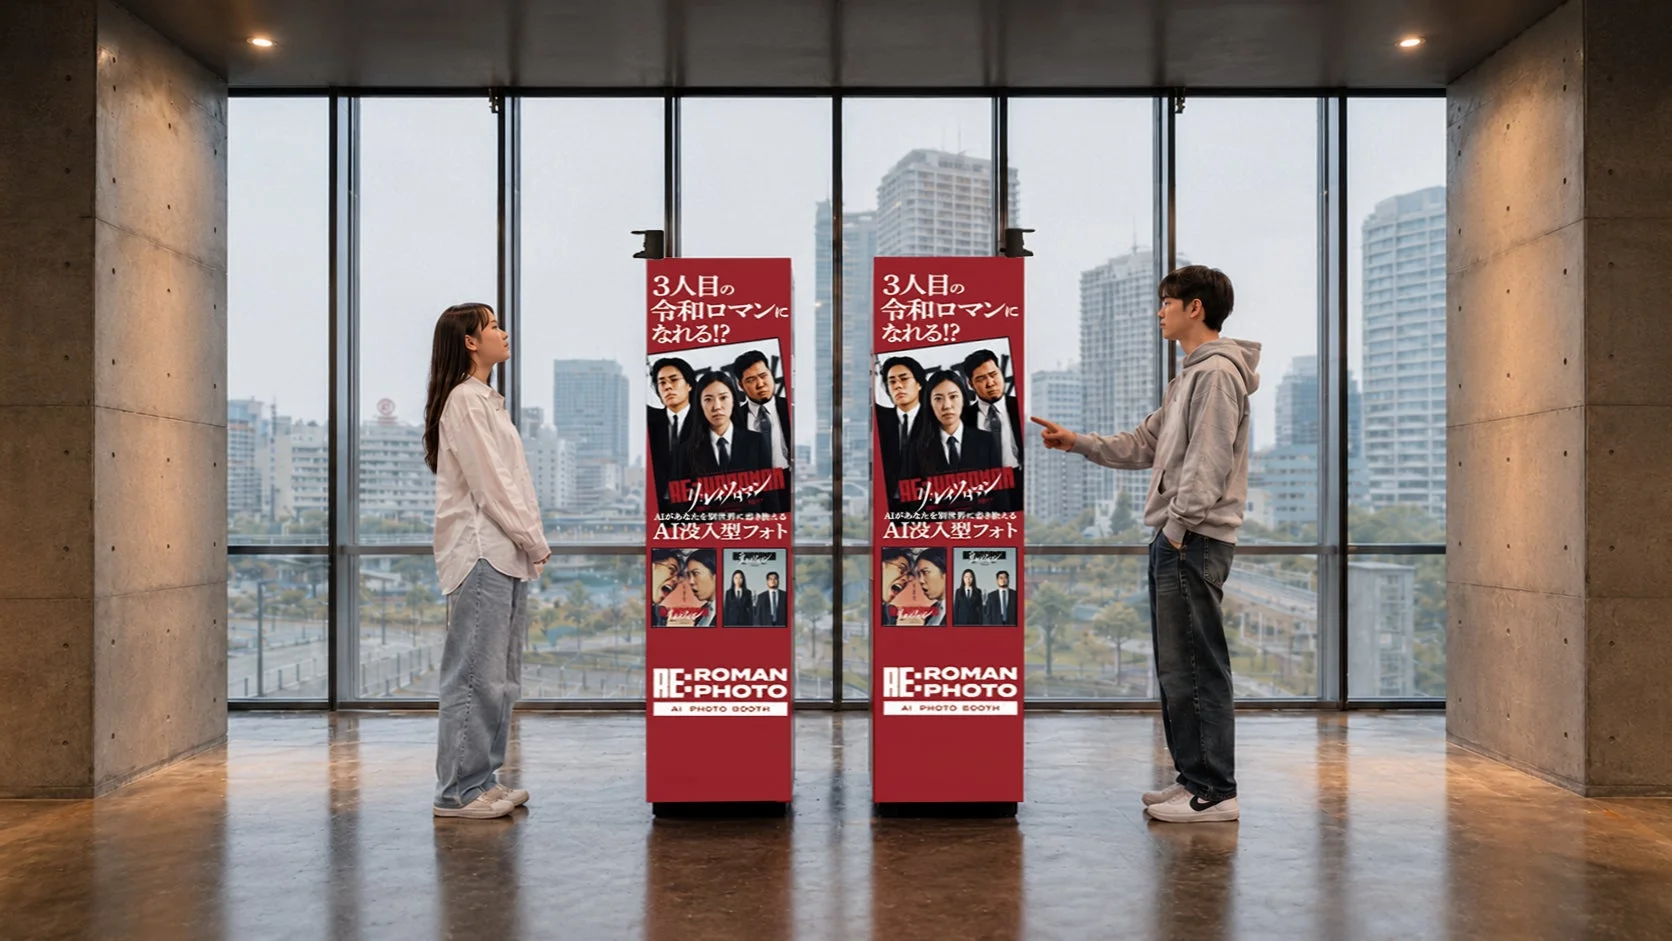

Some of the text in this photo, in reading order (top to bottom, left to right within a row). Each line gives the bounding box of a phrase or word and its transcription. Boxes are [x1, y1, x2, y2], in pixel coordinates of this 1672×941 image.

[653, 275, 735, 297] 3人目の
[883, 274, 965, 296] 3人目の
[650, 299, 789, 322] 令和ロマンに
[880, 298, 1019, 321] 令和ロマンに
[653, 522, 788, 540] AI没入型フォト
[883, 521, 1018, 539] AI没入型フォト
[694, 667, 787, 681] ROMAN
[924, 666, 1017, 680] ROMAN
[694, 684, 787, 698] PHOTO
[924, 683, 1017, 697] PHOTO
